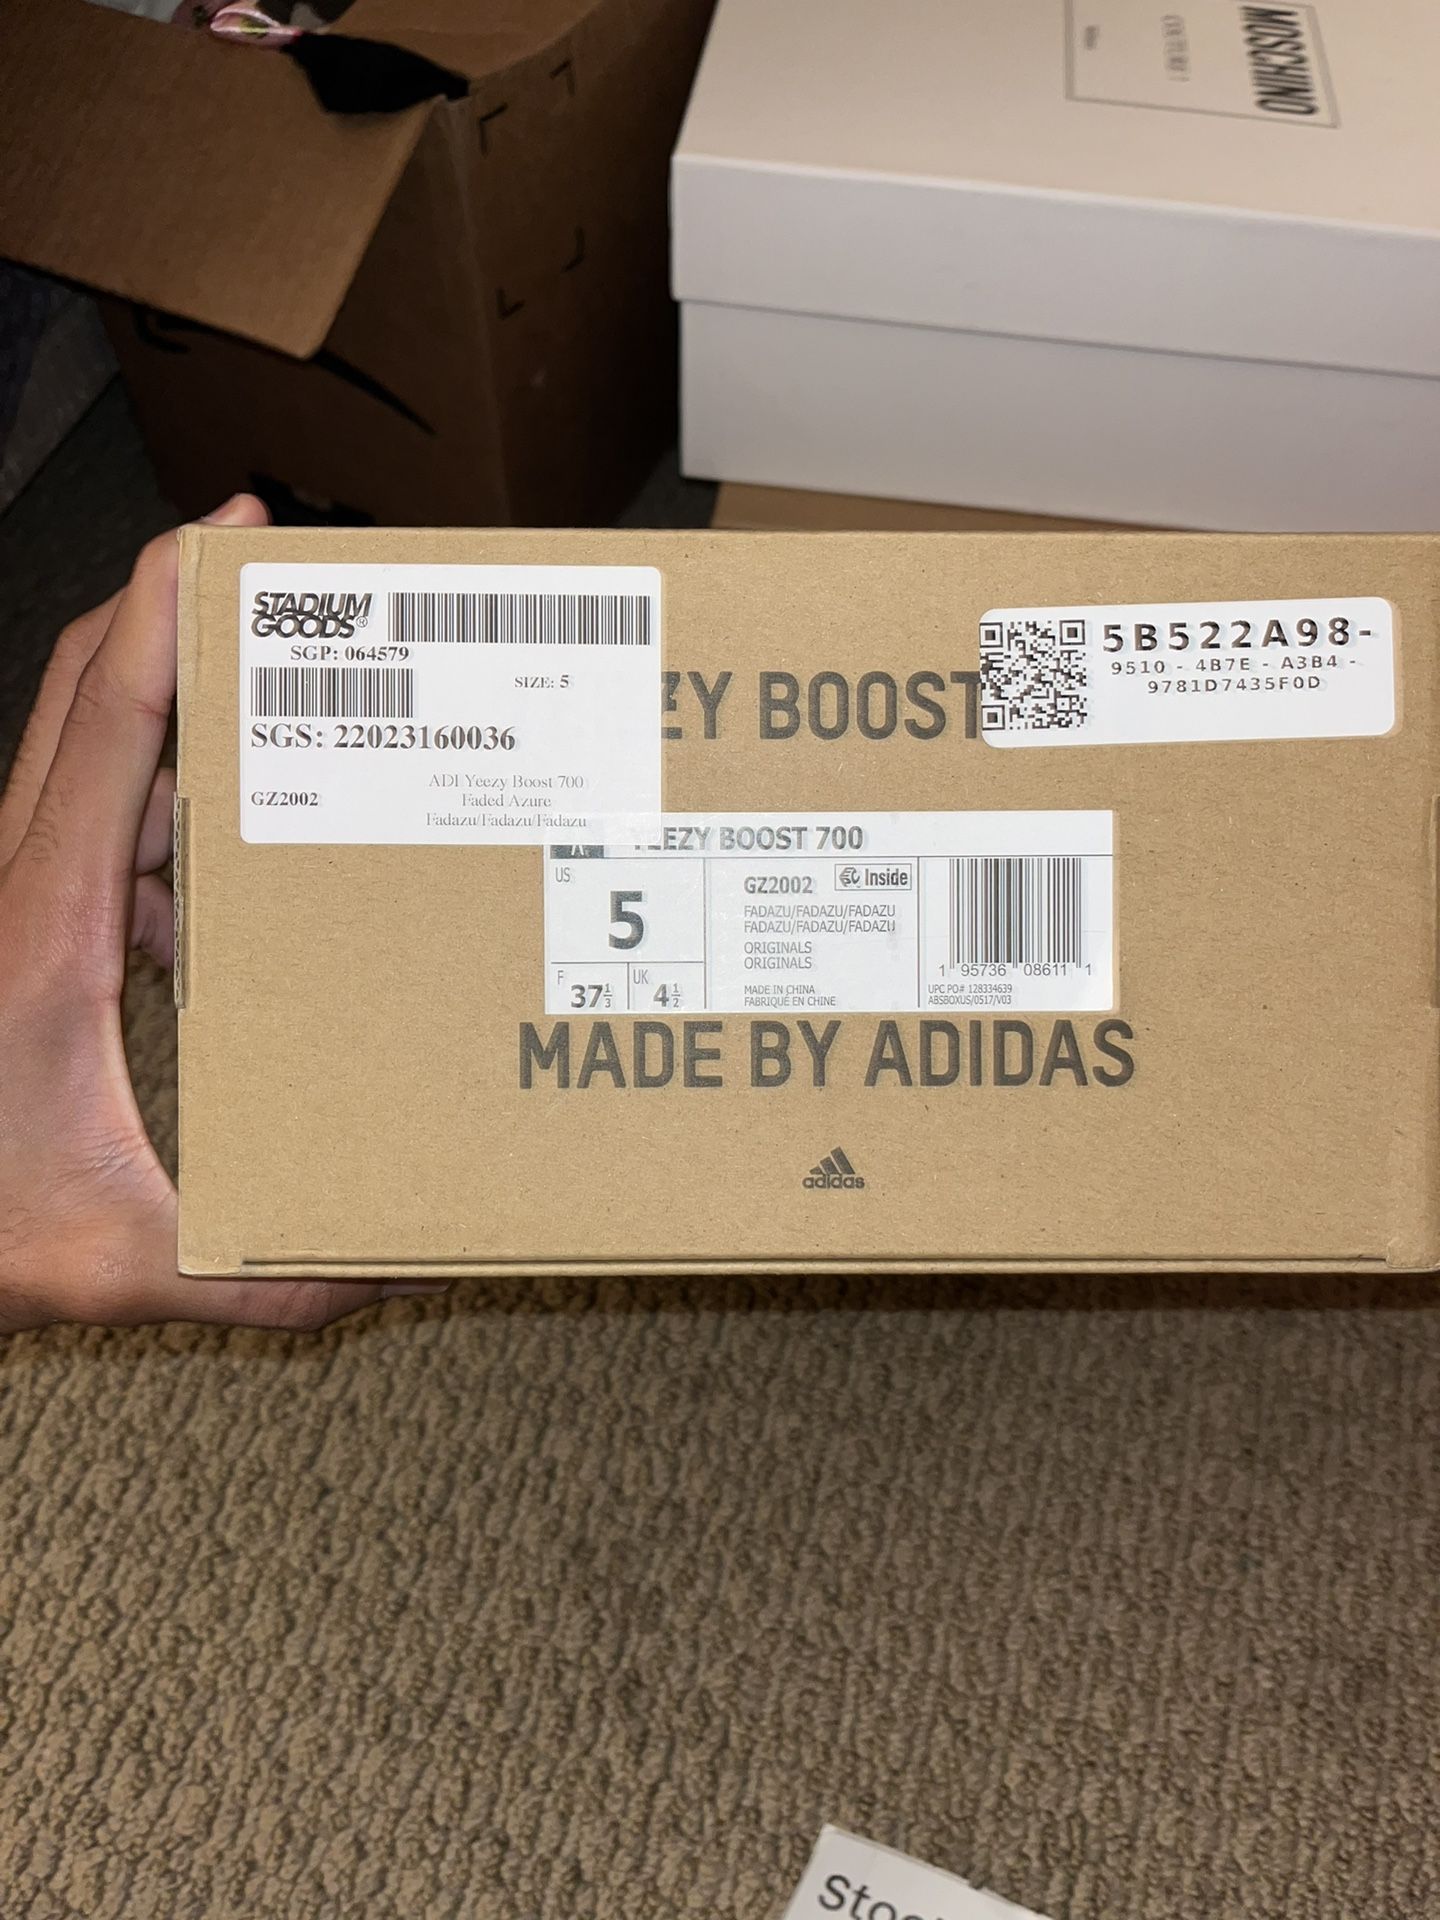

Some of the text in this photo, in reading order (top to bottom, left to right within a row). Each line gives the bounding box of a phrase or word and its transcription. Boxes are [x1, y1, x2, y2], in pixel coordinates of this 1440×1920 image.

[1239, 5, 1318, 115] MOSCHINO
[252, 591, 373, 617] STADIUM
[290, 645, 409, 661] SGP: 064579
[514, 674, 569, 689] SIZE: 5
[759, 671, 981, 740] BOOST
[251, 723, 516, 750] SGS: 22023160036
[428, 774, 584, 791] ADI Yeezy Boost 700
[251, 791, 319, 806] GZ2002
[462, 794, 551, 807] Faded Azure
[426, 812, 587, 828] Fadazu/Fadazu/Fadazu
[720, 826, 807, 850] BOOST
[816, 826, 863, 850] 700
[555, 867, 571, 883] US
[744, 868, 908, 894] GZ2002 Inside
[608, 890, 645, 950] 5
[744, 905, 896, 919] FADAZU/FADAZU/FADAZU
[744, 920, 896, 935] FADAZU/FADAZU/FADAZU
[744, 941, 812, 954] ORIGINALS
[744, 957, 812, 970] ORIGINALS
[939, 964, 1091, 976] 1 95736 08611 1
[557, 970, 648, 985] F UK
[744, 985, 815, 995] MADE IN CHINA
[928, 984, 1013, 994] UPC PO# 128334639
[793, 997, 805, 1006] EN
[808, 996, 835, 1006] CHINE
[519, 1019, 1135, 1089] MADE BY ADIDAS
[802, 1173, 865, 1189] adidas
[818, 1874, 945, 1920] Sto
